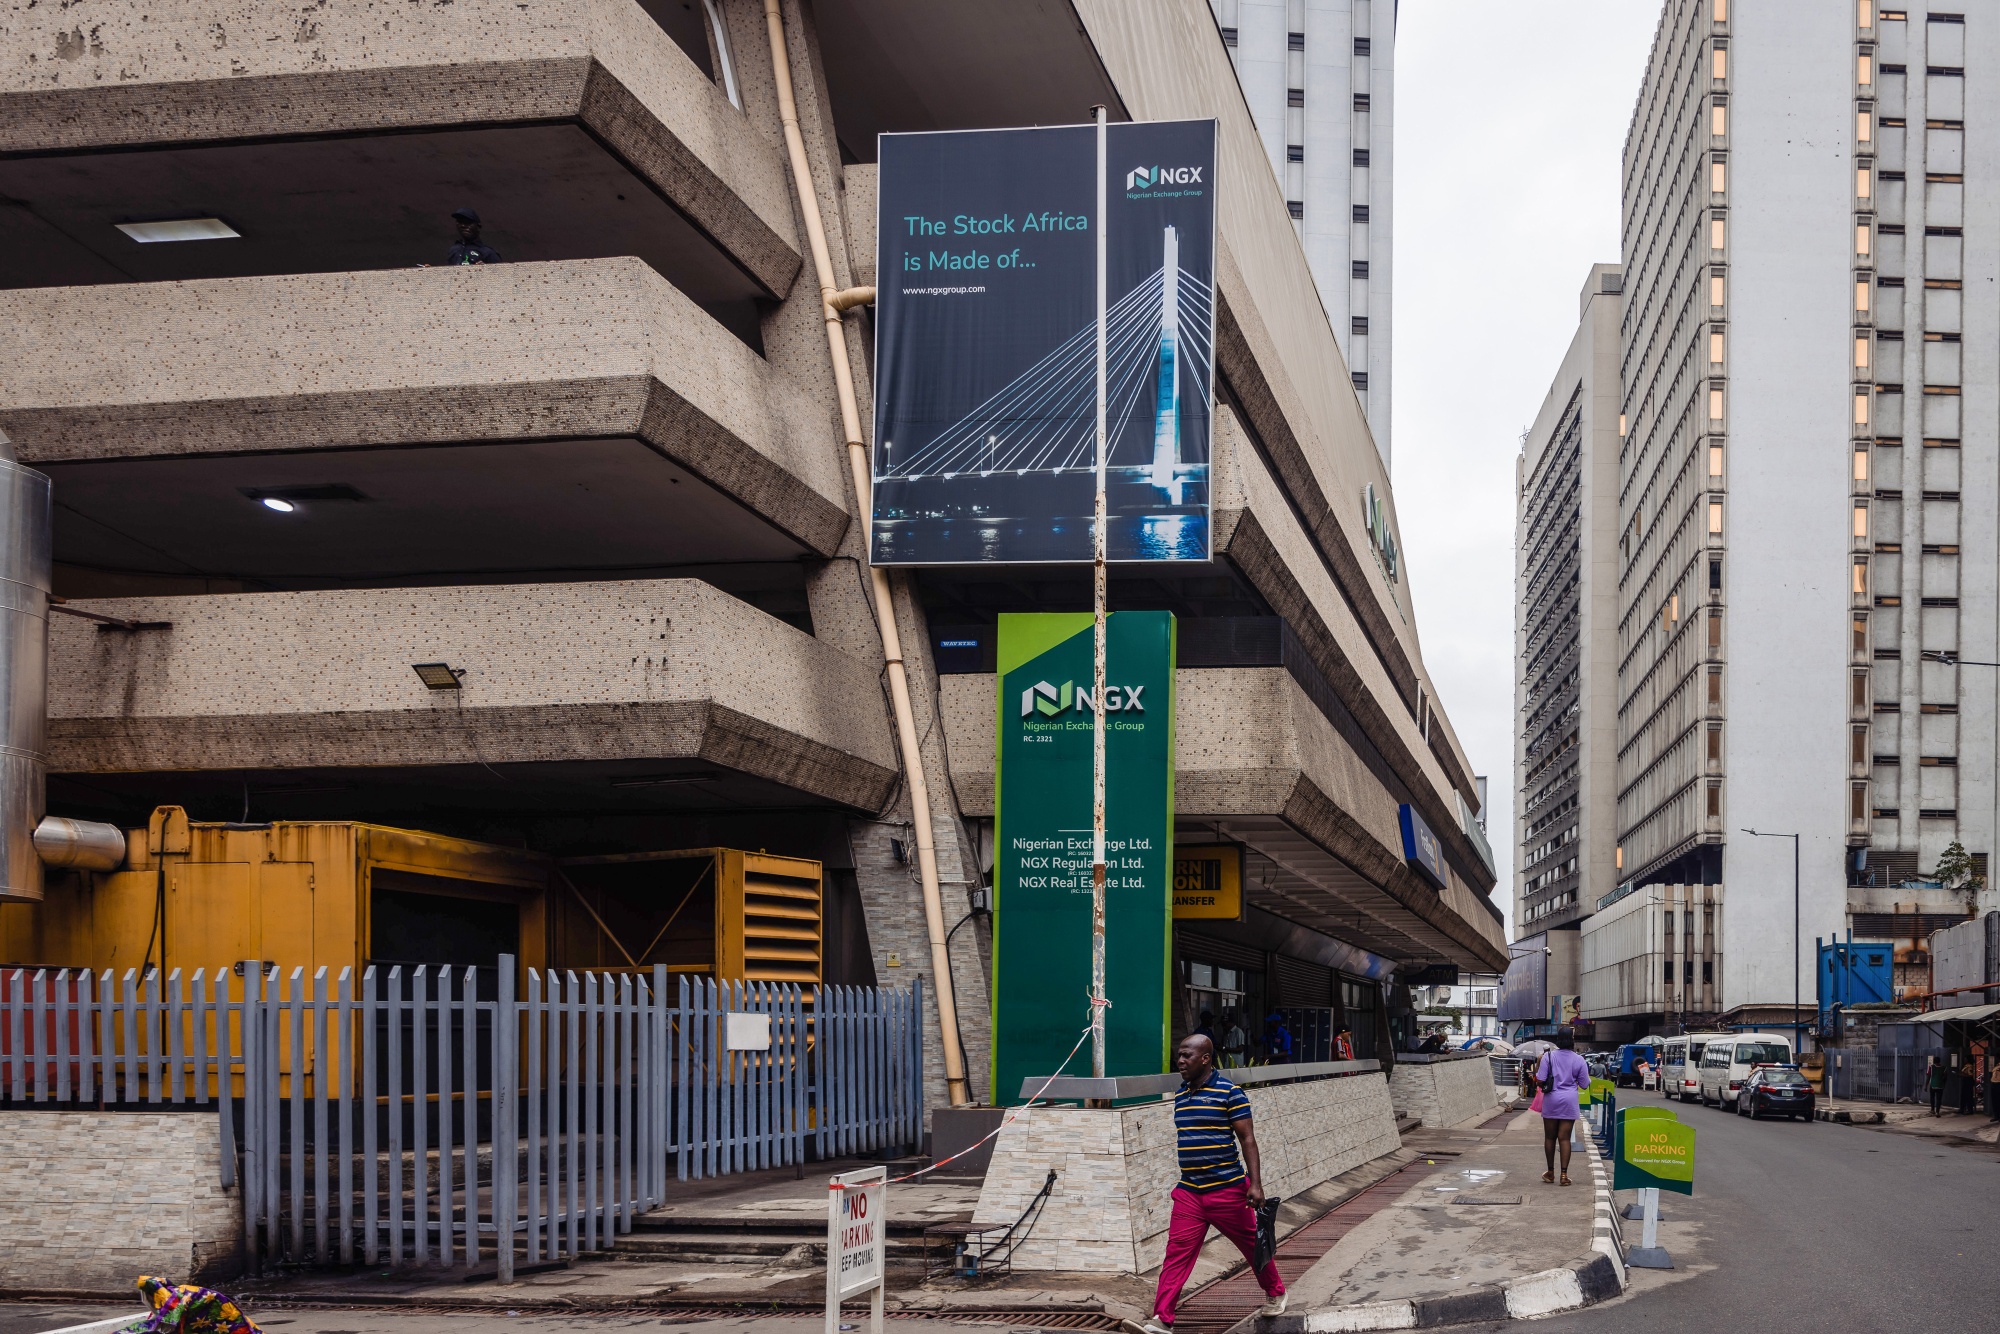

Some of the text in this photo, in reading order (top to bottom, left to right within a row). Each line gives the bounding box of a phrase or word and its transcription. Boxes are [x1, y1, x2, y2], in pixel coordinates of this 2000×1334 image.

[1160, 166, 1203, 185] NGX
[1126, 192, 1152, 200] Nigerian
[1153, 190, 1182, 198] Exchange
[903, 211, 1088, 236] The Stock Africa
[904, 248, 1036, 272] is Made of...
[902, 285, 986, 296] www.ngxgroup.com
[1076, 685, 1145, 712] NGX
[1023, 721, 1145, 732] Nigerian Exchae Group
[1012, 838, 1152, 852] Nigerian Exchnge Ltd.
[1020, 857, 1145, 871] NGX Regulaon Ltd.
[1019, 876, 1145, 888] NGX Real Este Ltd.
[1429, 969, 1454, 980] ATM
[1650, 1133, 1668, 1143] NO
[1634, 1144, 1686, 1156] PARKING
[850, 1192, 867, 1220] NO
